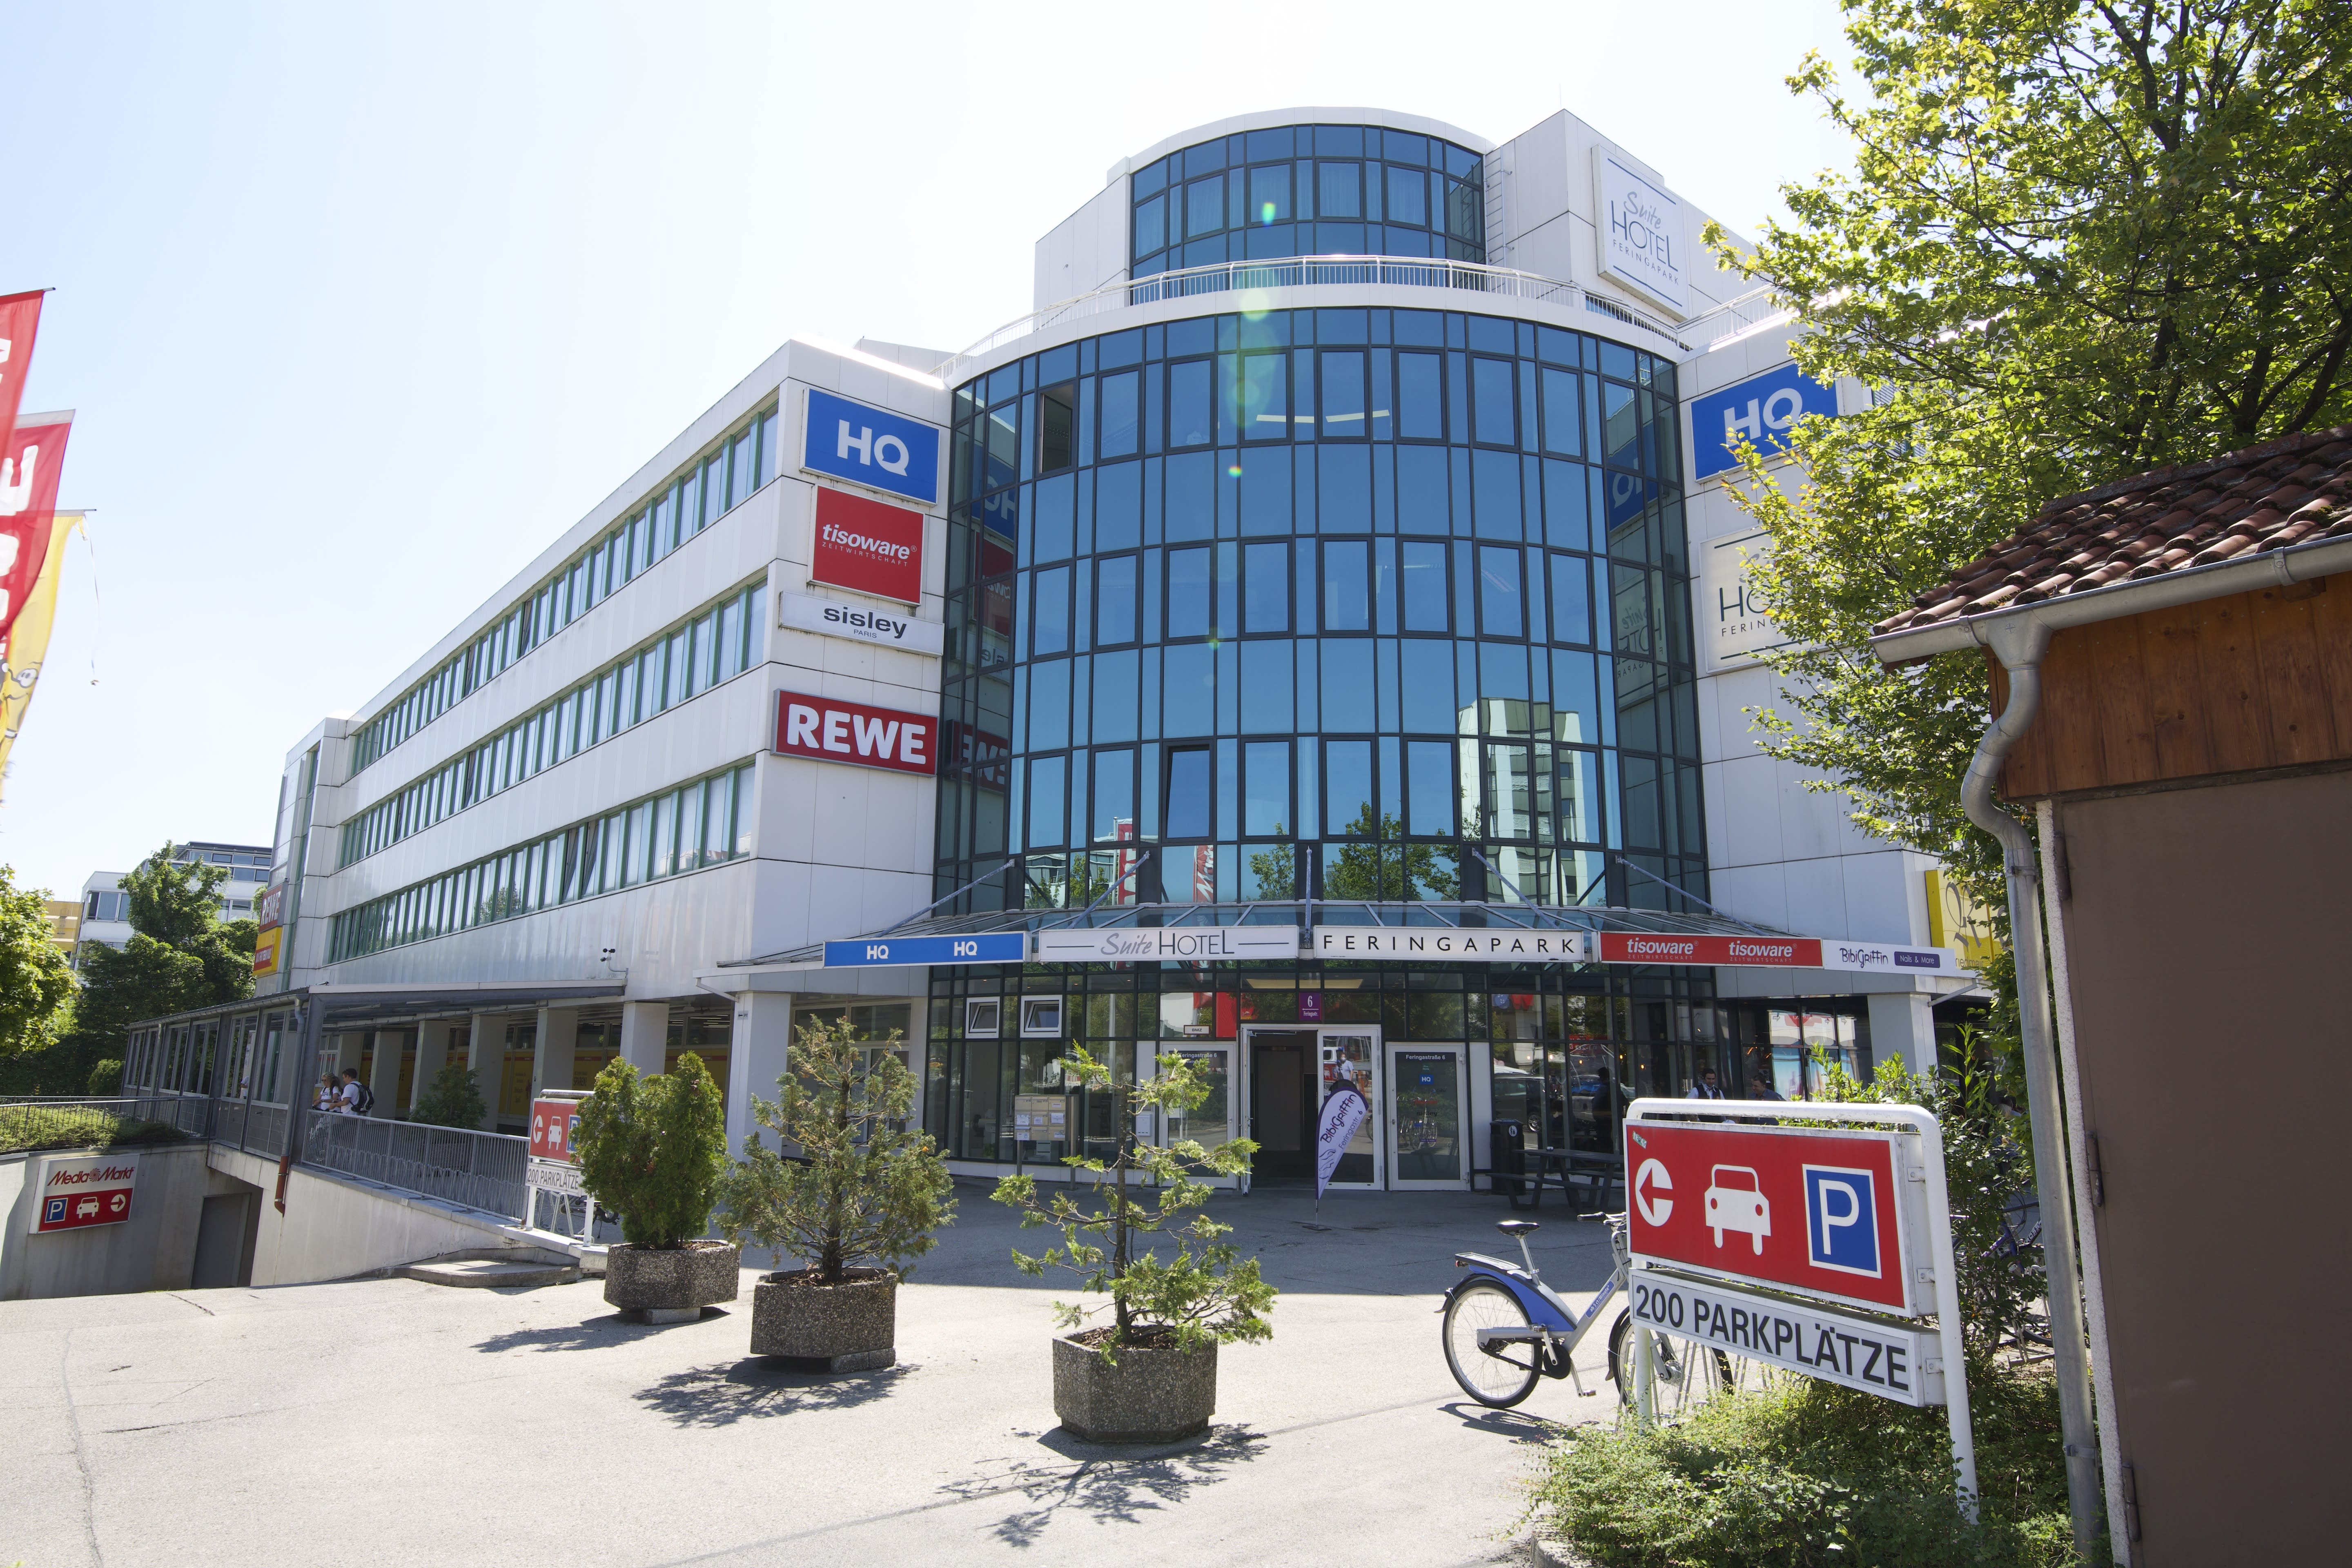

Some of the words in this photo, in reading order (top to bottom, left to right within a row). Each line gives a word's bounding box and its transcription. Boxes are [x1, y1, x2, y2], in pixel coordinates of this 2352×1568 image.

[1624, 191, 1661, 229] Suite
[1611, 200, 1678, 272] HOTEL
[1613, 239, 1679, 285] FERINGAPARK
[1723, 388, 1803, 448] HQ
[836, 419, 909, 477] HQ
[822, 541, 908, 567] ZEITWIRTSCHAFT
[824, 606, 907, 639] sisley
[853, 629, 877, 638] PARIS
[786, 703, 927, 765] REWE
[260, 891, 281, 927] REWE
[866, 944, 889, 960] HQ
[954, 941, 978, 956] HQ
[1100, 933, 1153, 955] Suite
[1159, 929, 1235, 955] HOTEL
[1323, 935, 1575, 954] FERINGAPARK
[1307, 996, 1313, 1007] 6
[1339, 1117, 1361, 1149] Feringastr.
[528, 1168, 539, 1183] 200
[540, 1170, 579, 1190] PARKPLÄTZE
[49, 1201, 63, 1220] P
[1818, 1179, 1860, 1256] P
[1636, 1285, 1684, 1328] 200
[1694, 1298, 1909, 1392] PARKPLÄTZE
